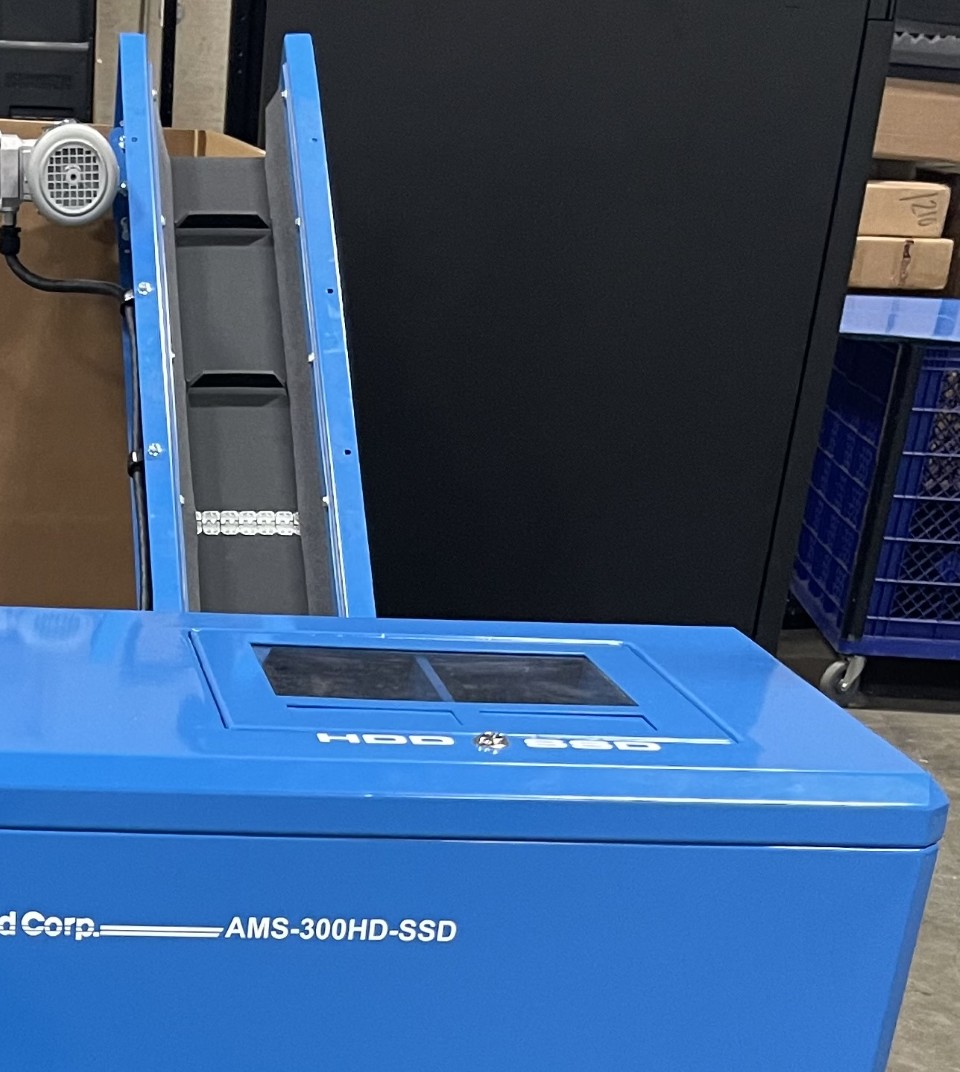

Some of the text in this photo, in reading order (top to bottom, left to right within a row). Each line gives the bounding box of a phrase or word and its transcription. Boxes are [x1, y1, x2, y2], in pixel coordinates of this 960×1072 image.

[316, 733, 662, 752] HDD SSD
[21, 911, 100, 941] Corp.
[225, 916, 457, 942] AMS-300HD-SSD
